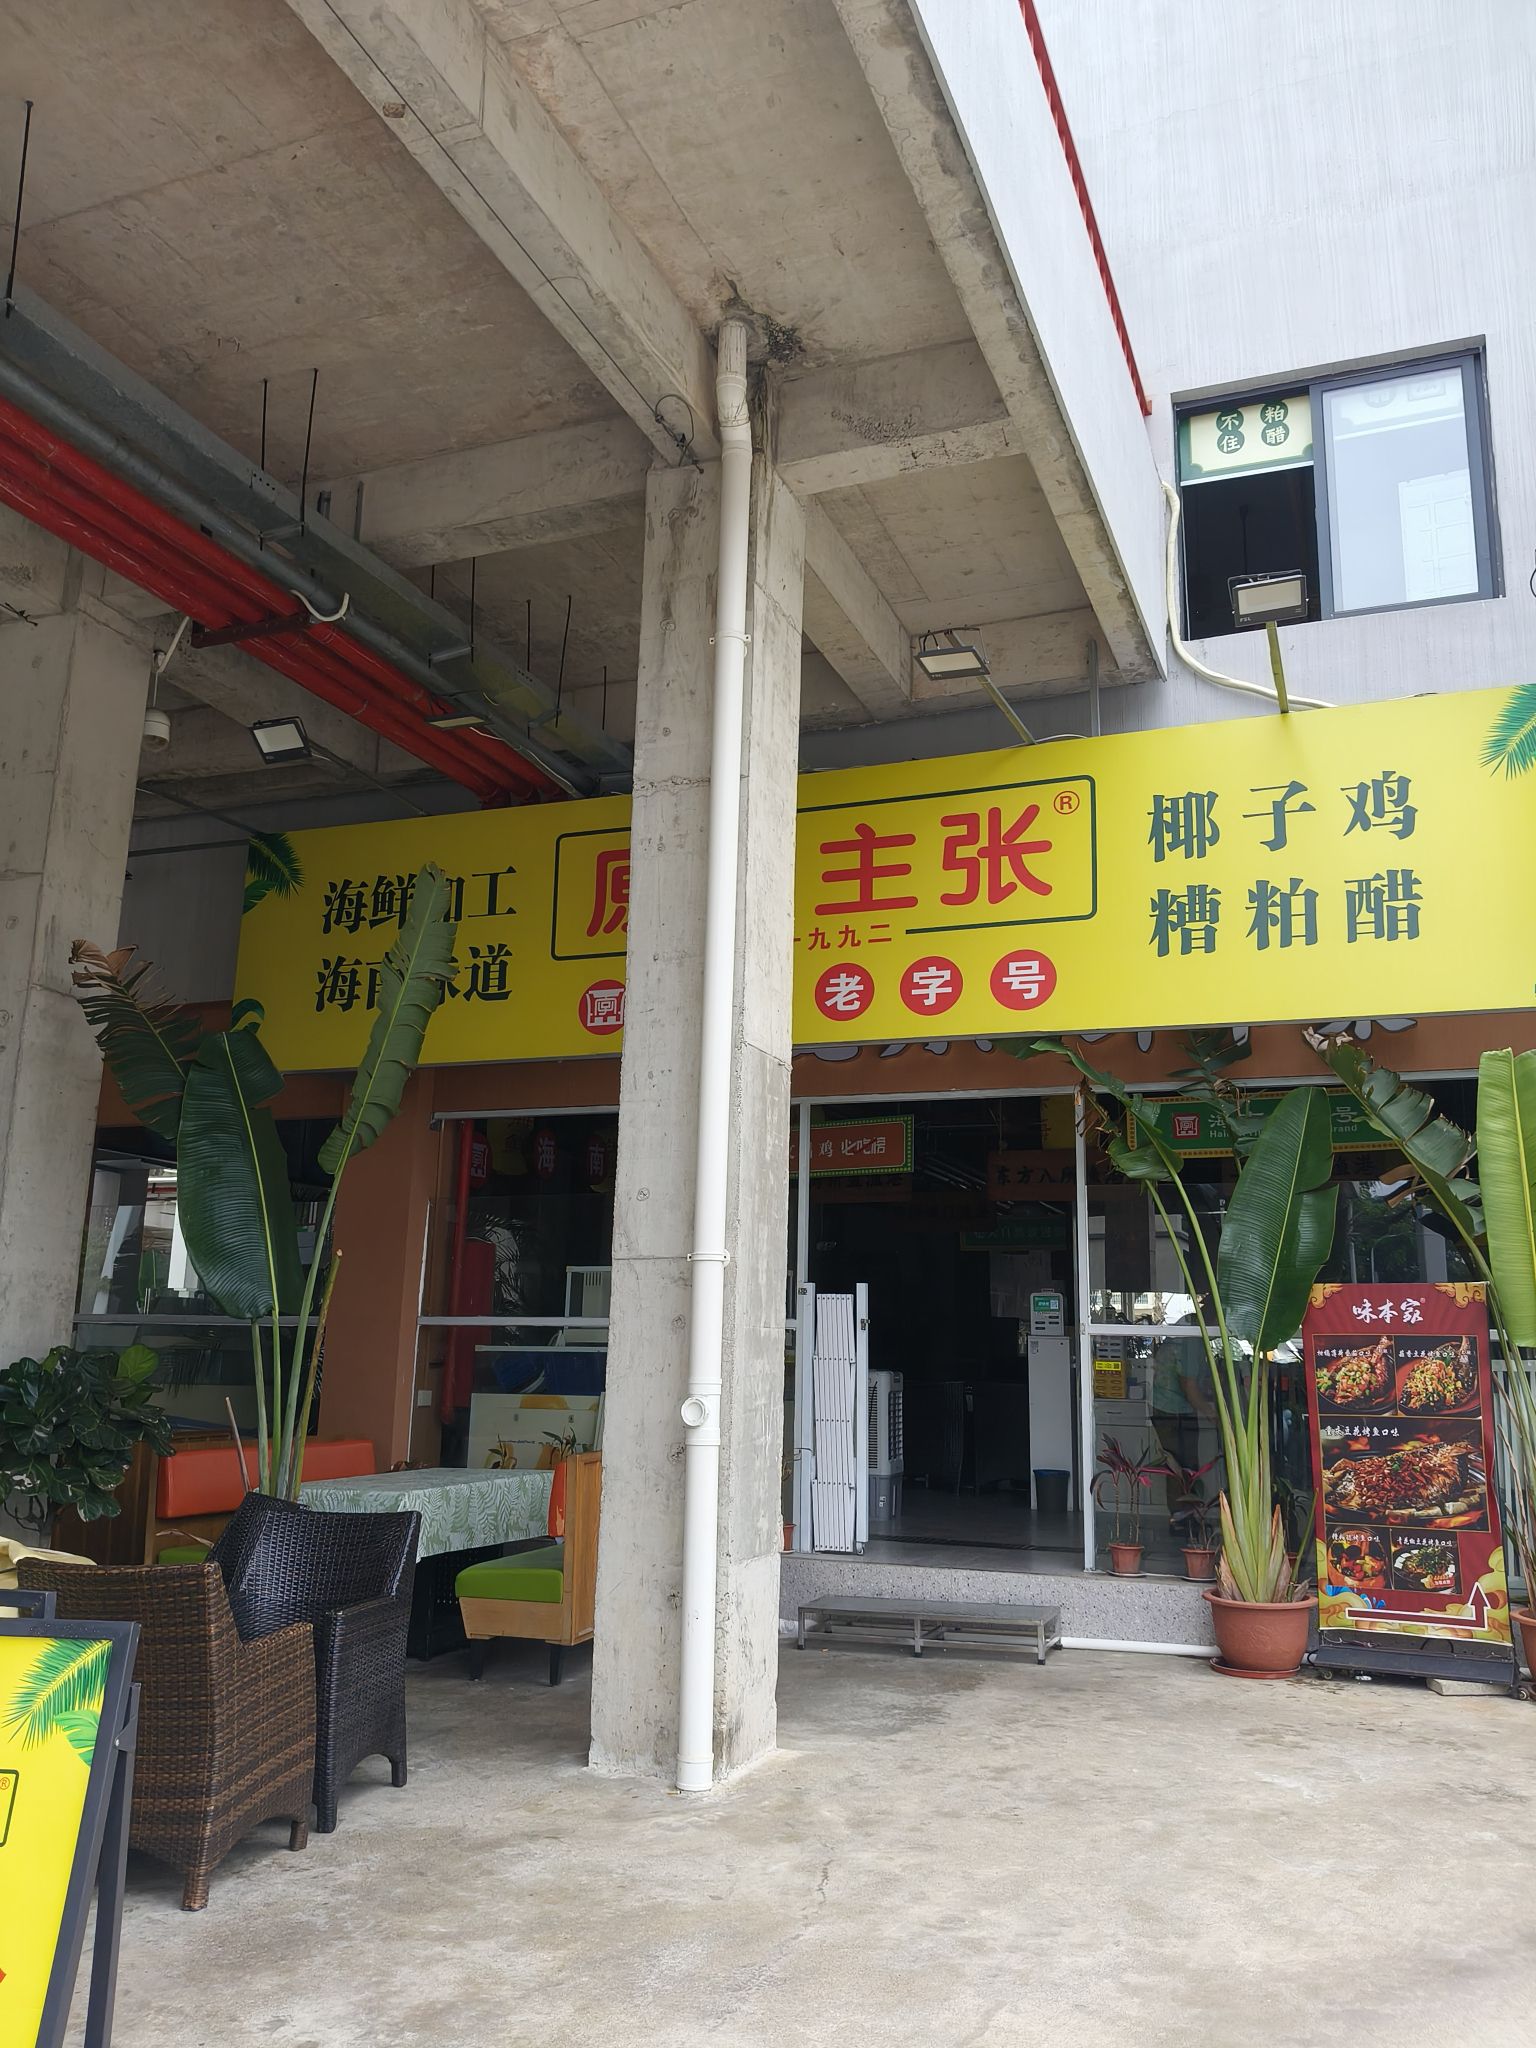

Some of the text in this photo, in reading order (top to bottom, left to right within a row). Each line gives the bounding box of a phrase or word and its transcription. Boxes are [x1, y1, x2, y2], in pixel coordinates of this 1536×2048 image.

[1148, 771, 1418, 863] 椰子鸡
[1148, 869, 1424, 958] 糟粕醋
[794, 924, 892, 951] 九九二
[1333, 1124, 1357, 1133] rand
[1352, 1298, 1424, 1325] 味本家
